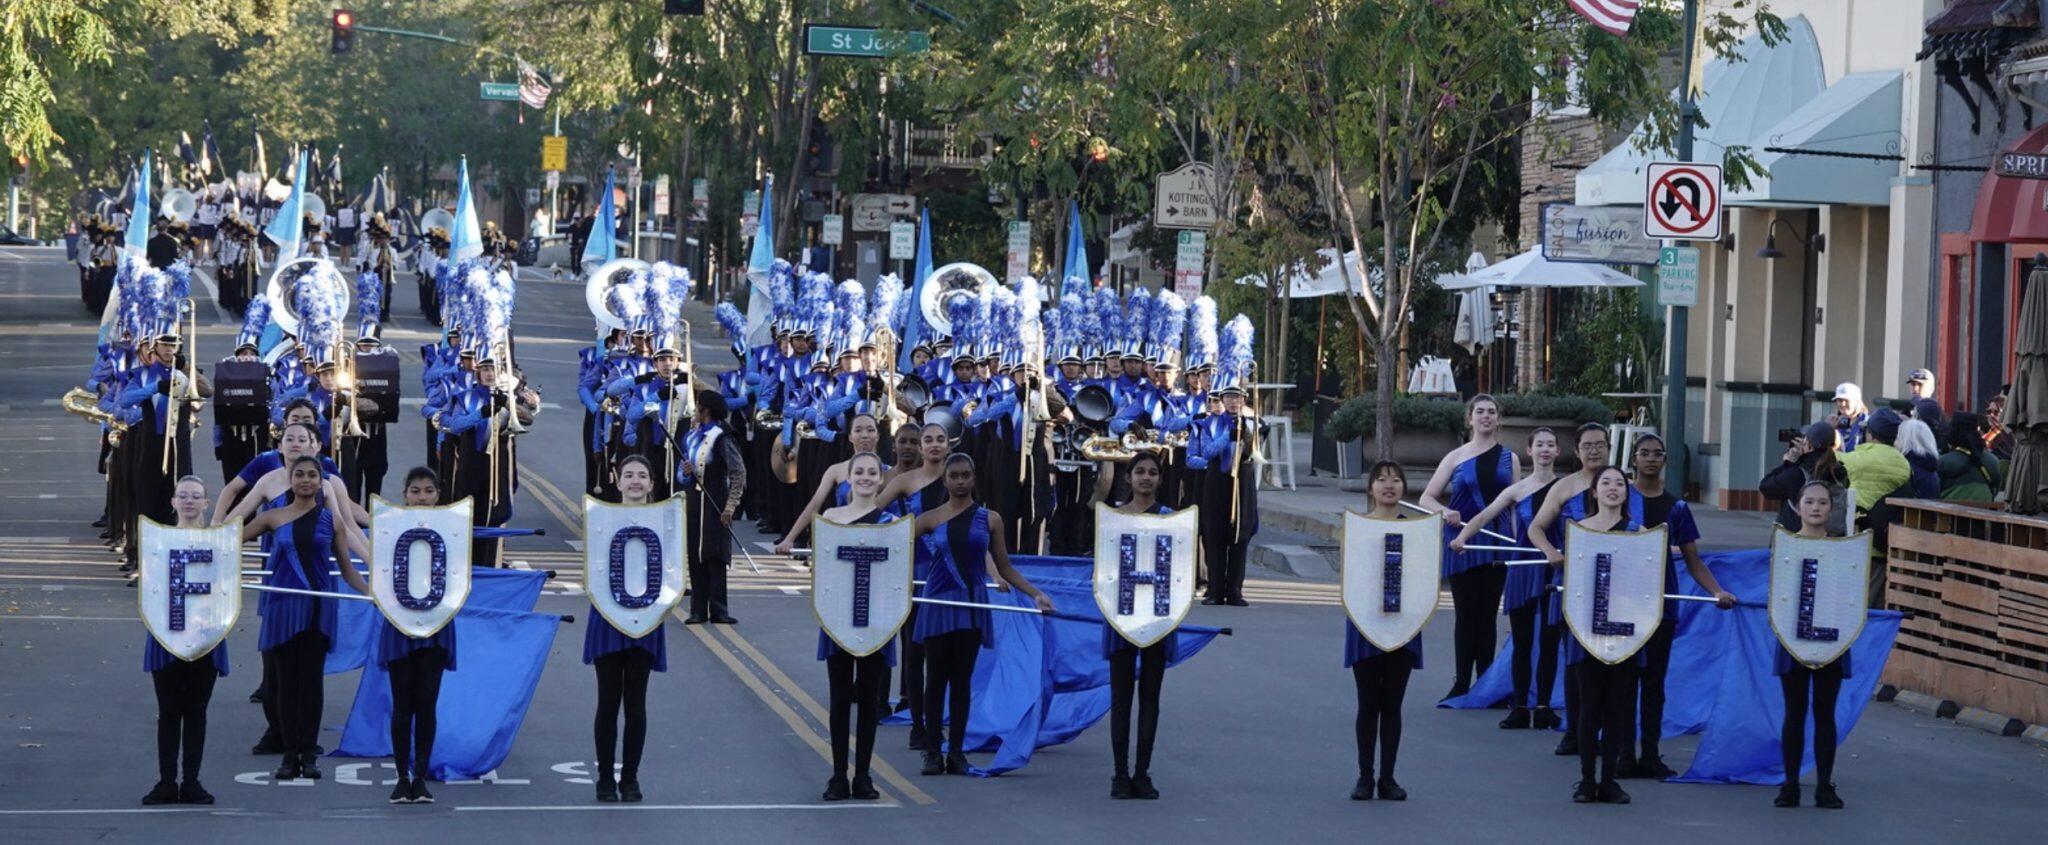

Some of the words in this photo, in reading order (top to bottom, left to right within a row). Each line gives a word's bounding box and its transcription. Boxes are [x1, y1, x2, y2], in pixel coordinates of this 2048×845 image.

[832, 32, 852, 49] St
[1183, 207, 1208, 217] BARN
[1551, 206, 1565, 258] SALON
[1576, 217, 1631, 244] fusion
[1662, 267, 1696, 281] PARKING
[1666, 251, 1675, 264] 3
[366, 379, 389, 387] YAMAHA
[169, 549, 213, 631] F
[393, 527, 447, 611] O
[609, 526, 663, 609] O
[837, 545, 889, 627] T
[1118, 533, 1172, 616] H
[1383, 533, 1403, 613] I
[1592, 553, 1635, 637] L
[1797, 558, 1839, 642] L
